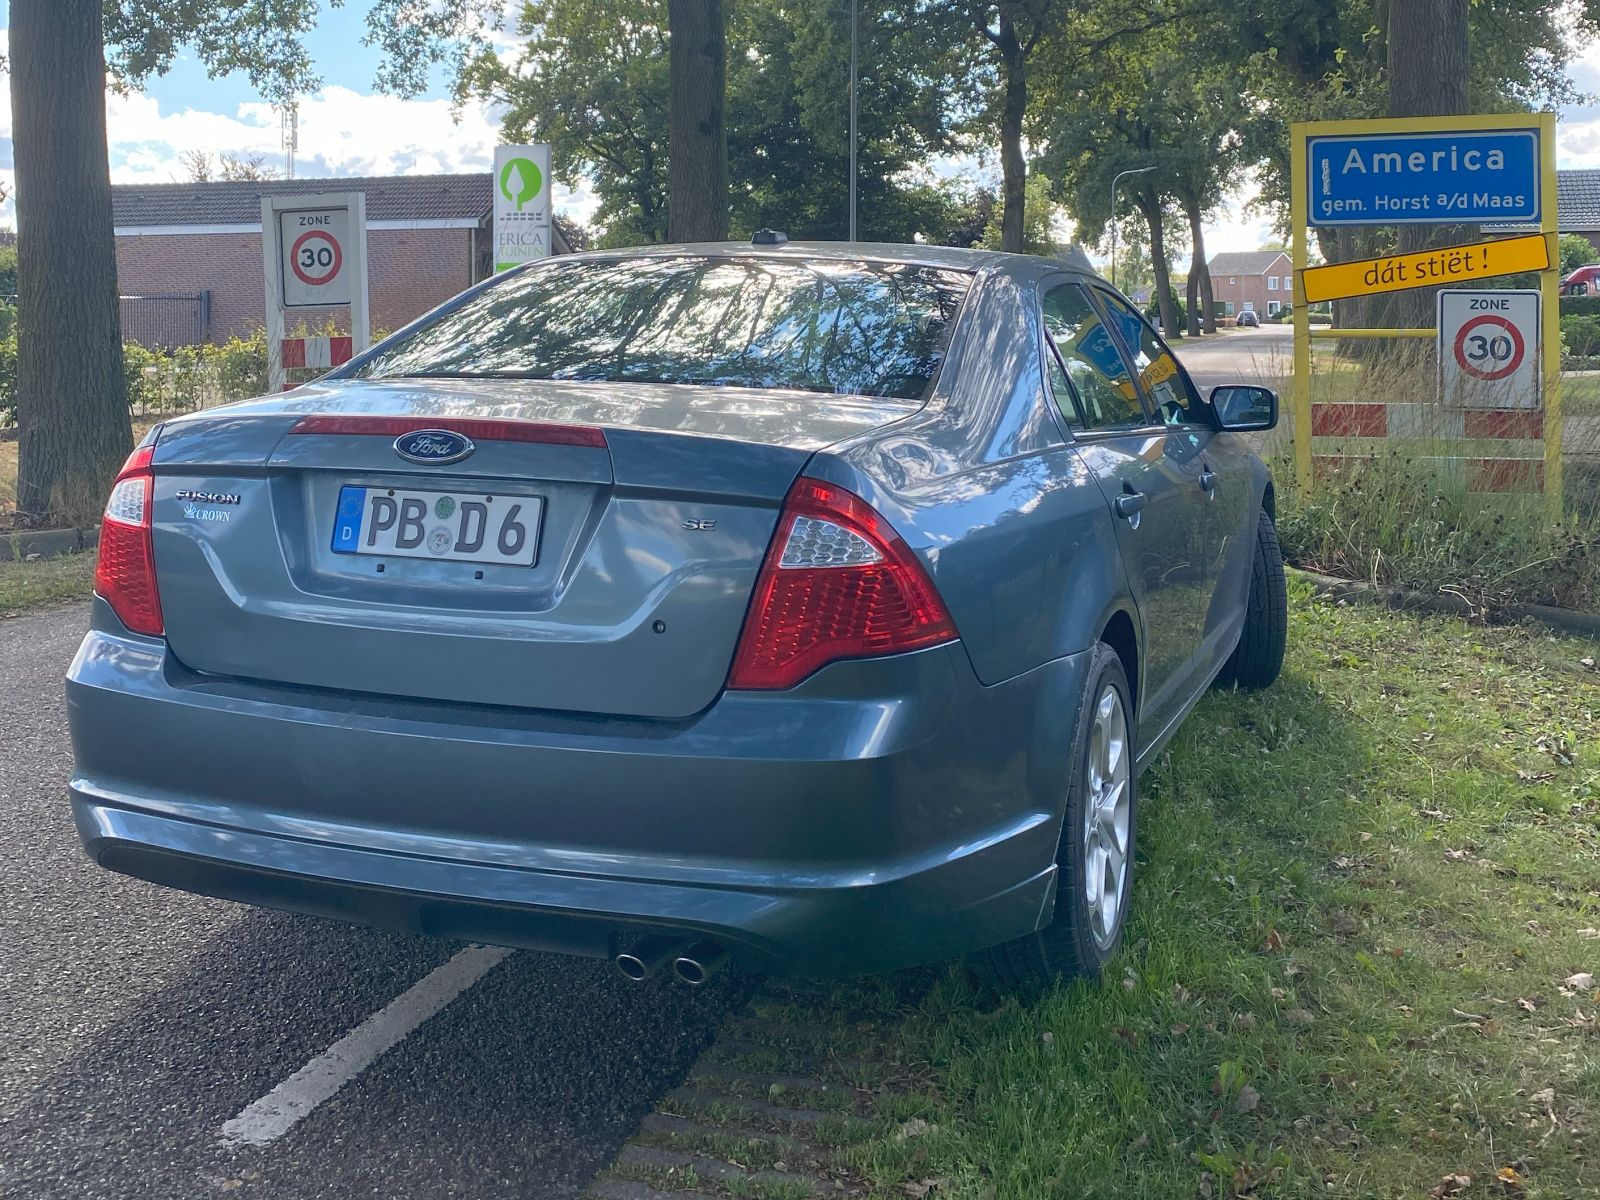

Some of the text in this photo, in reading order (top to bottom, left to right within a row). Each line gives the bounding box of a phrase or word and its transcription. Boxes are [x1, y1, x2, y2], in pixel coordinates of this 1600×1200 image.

[1341, 145, 1504, 175] America
[1321, 192, 1525, 216] gem. Horst a/d Maas
[299, 216, 331, 226] ZONE
[500, 232, 544, 246] ERICA
[301, 247, 332, 267] 30
[499, 246, 544, 257] TUINEN
[1364, 260, 1407, 286] dát
[1415, 251, 1474, 279] stiët
[1470, 299, 1510, 310] ZONE
[1468, 335, 1512, 361] 30
[409, 434, 453, 455] Ford
[175, 490, 241, 505] FUSION
[196, 508, 231, 522] CROWN
[366, 496, 428, 549] PB
[453, 501, 488, 553] D
[497, 504, 526, 556] 6
[682, 518, 718, 531] SE
[341, 526, 352, 541] D
